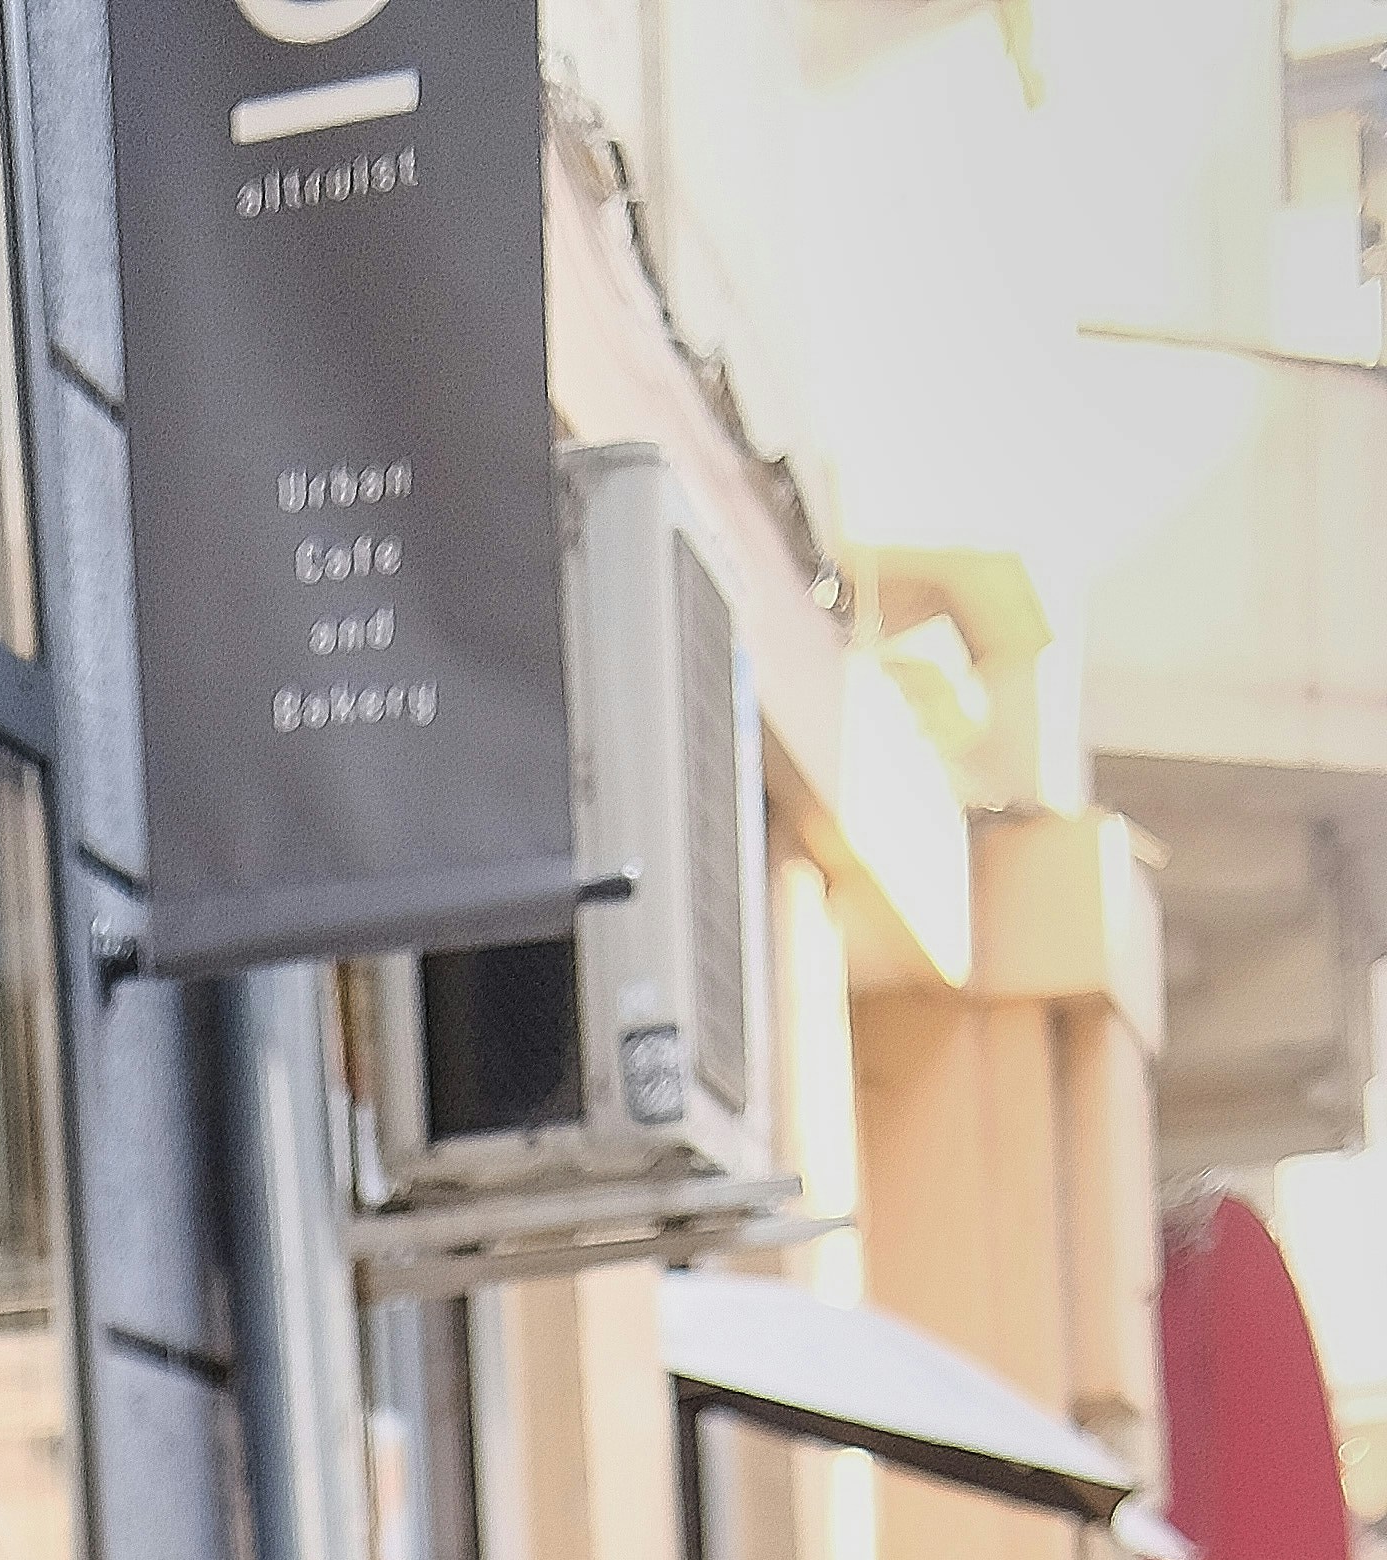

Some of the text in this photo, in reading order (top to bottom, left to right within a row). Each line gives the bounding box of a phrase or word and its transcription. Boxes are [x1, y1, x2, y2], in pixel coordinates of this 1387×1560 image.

[236, 146, 418, 217] altruist
[277, 460, 412, 513] Urban
[295, 535, 402, 584] Cafe
[309, 608, 394, 655] and
[273, 683, 436, 732] Bakery
